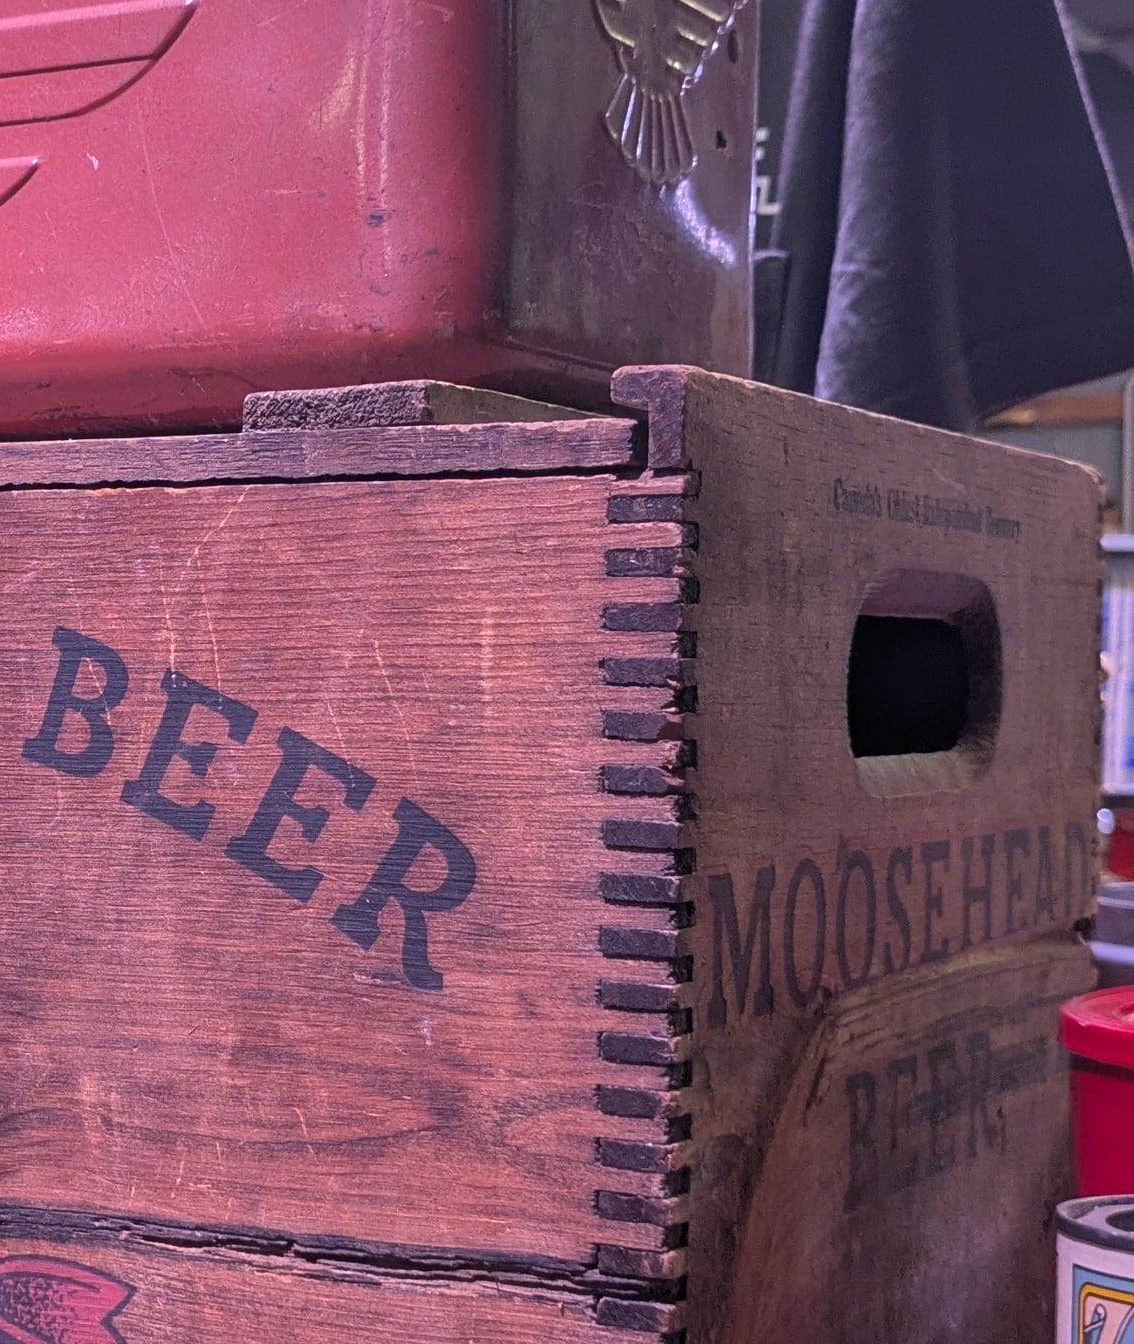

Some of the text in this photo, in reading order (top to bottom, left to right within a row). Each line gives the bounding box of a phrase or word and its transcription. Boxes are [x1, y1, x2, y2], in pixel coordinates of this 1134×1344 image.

[21, 626, 477, 991] BEER
[707, 821, 1092, 1030] MOOSEHEAD
[843, 1032, 1002, 1212] BEER
